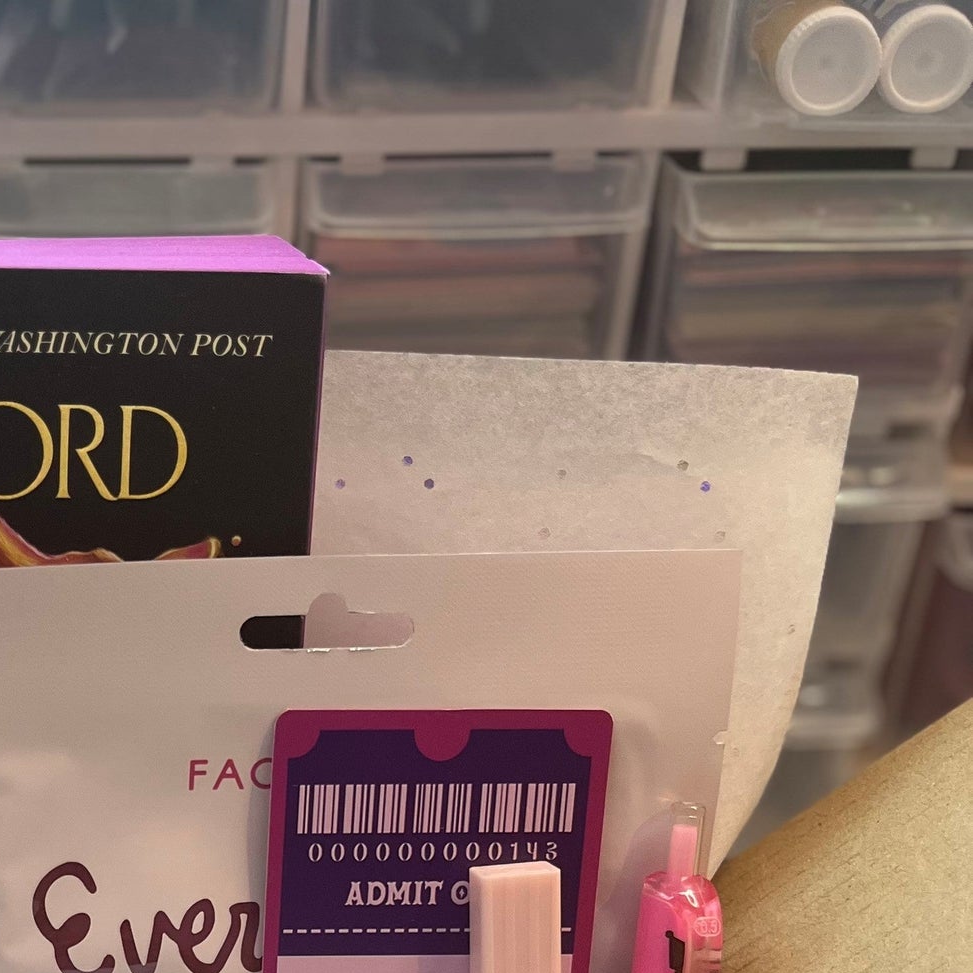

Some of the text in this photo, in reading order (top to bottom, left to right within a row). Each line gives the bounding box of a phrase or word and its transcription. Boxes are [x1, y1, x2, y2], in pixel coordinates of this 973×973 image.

[190, 333, 274, 358] POST
[188, 757, 273, 790] FAC
[344, 879, 444, 906] ADMIT
